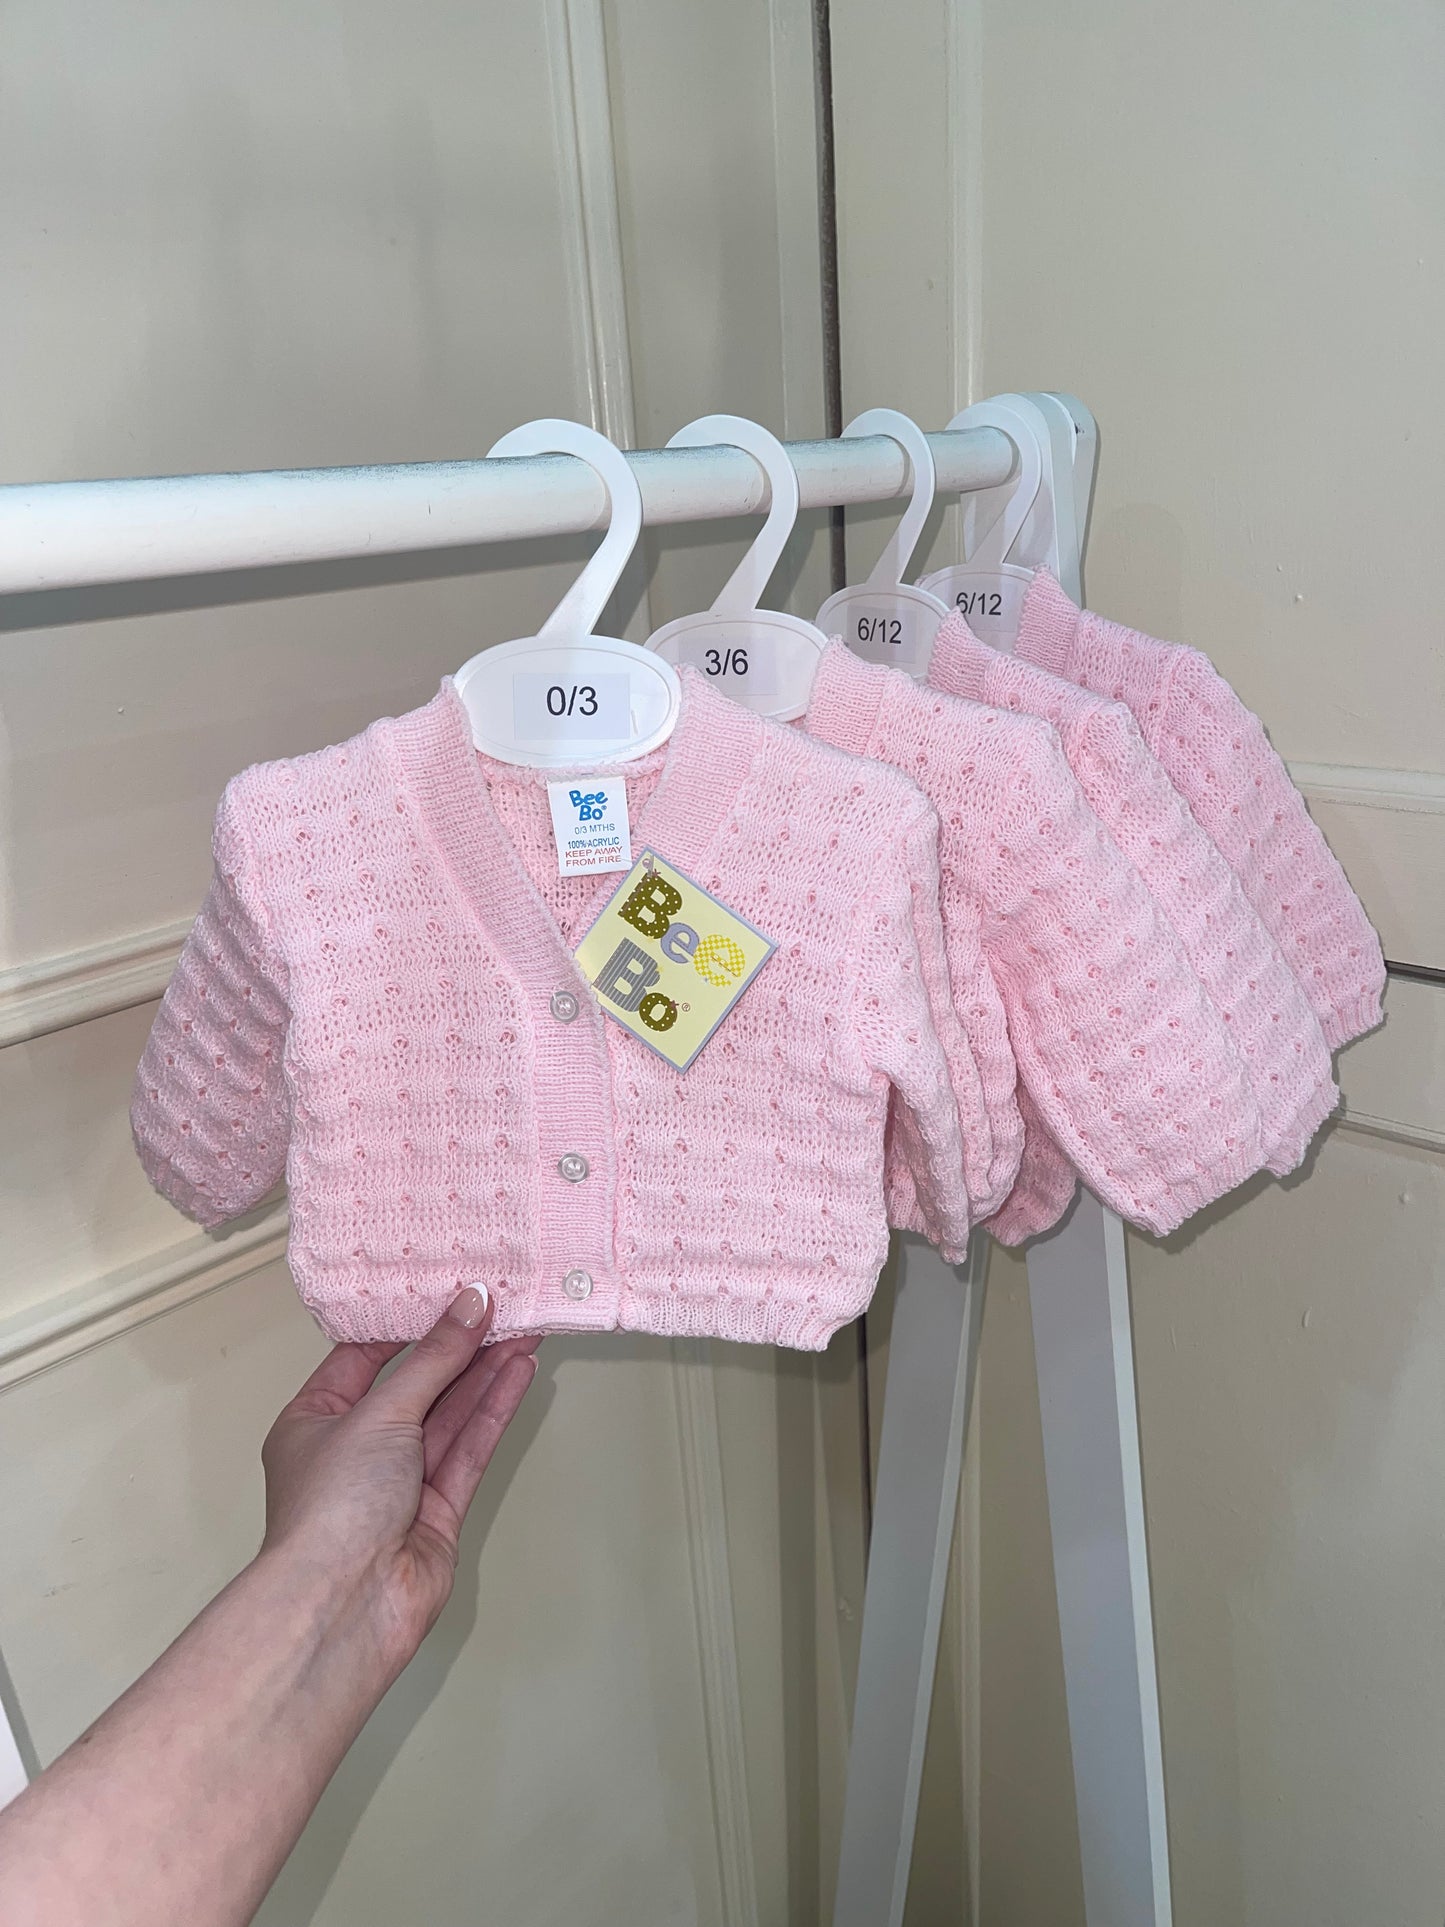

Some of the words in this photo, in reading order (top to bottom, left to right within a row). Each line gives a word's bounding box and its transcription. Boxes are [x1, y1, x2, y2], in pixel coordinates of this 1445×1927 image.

[956, 592, 1002, 616] 6/12
[857, 618, 902, 644] 6/12
[704, 649, 749, 676] 3/6
[546, 686, 599, 716] 0/3
[569, 790, 608, 807] Bee
[574, 826, 588, 835] 0/3
[589, 823, 616, 833] MTHS
[565, 848, 593, 859] KEEP
[594, 846, 623, 856] AWAY
[565, 857, 597, 868] FROM
[598, 855, 622, 865] FIRE
[617, 870, 746, 987] Bee
